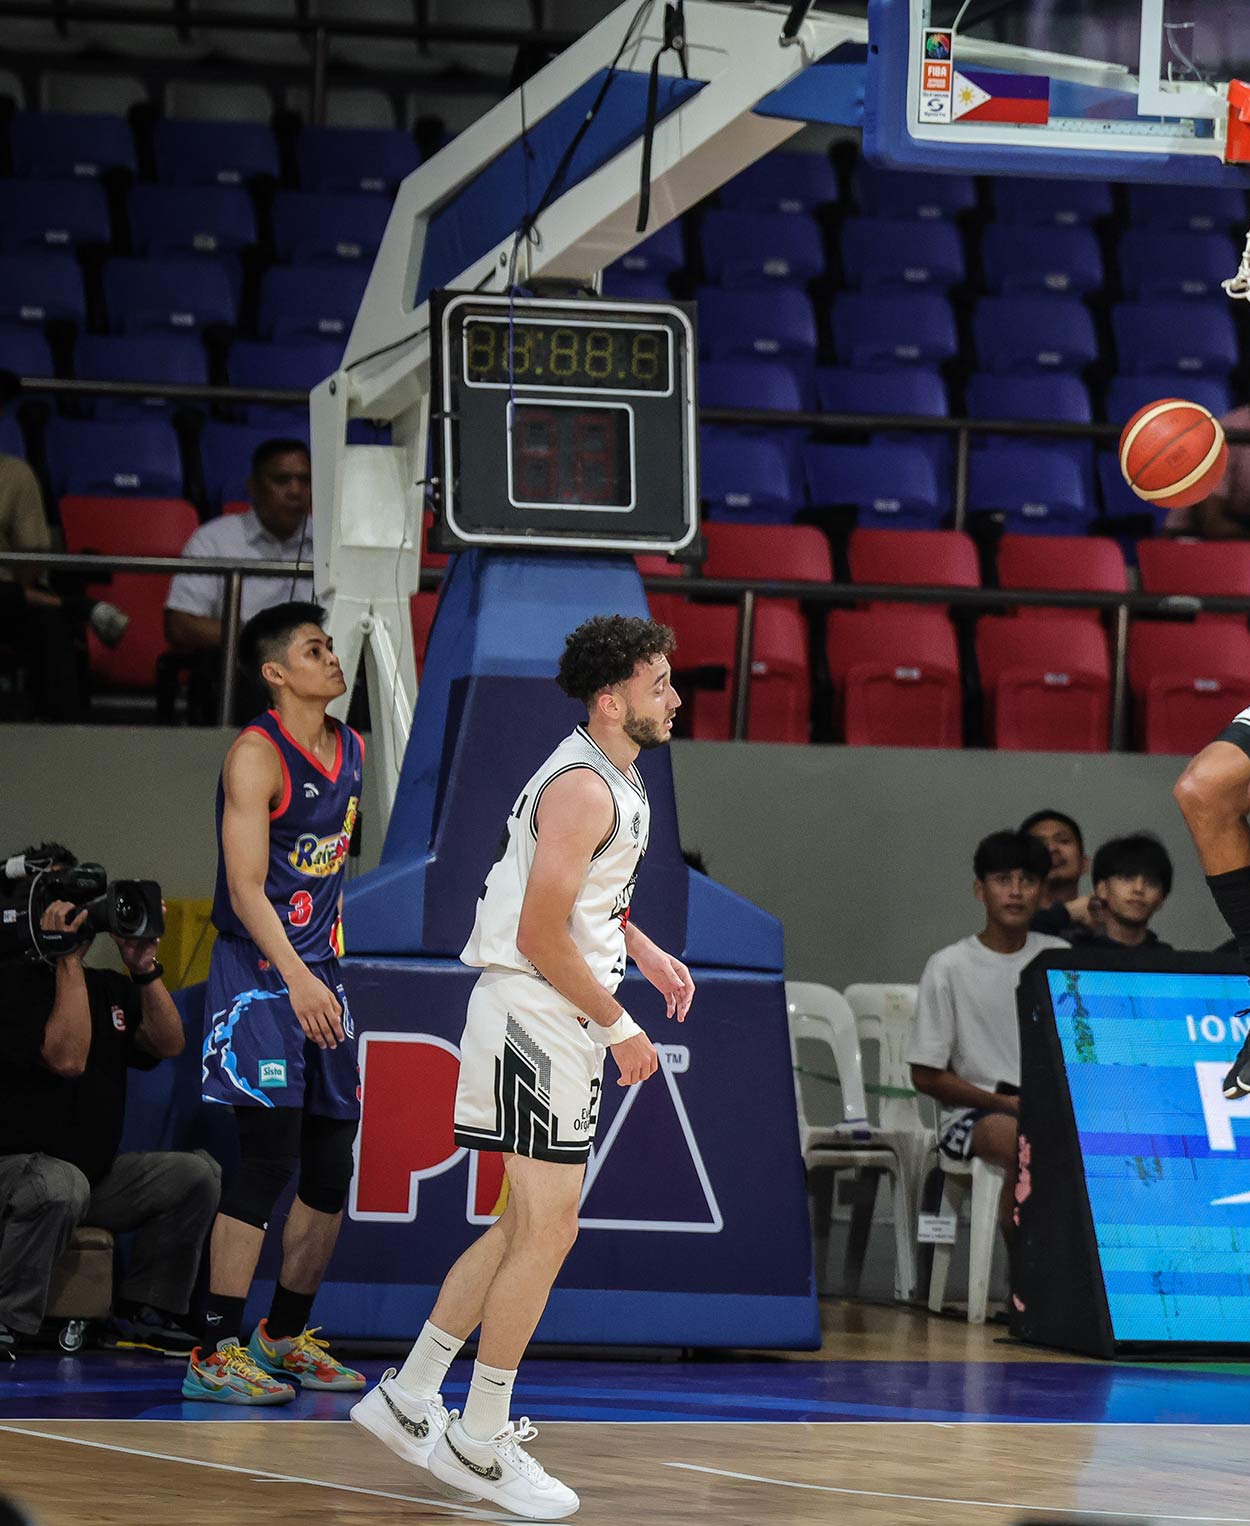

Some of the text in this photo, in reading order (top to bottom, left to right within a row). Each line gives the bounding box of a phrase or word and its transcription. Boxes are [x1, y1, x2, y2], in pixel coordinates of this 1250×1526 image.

[288, 890, 312, 927] 3
[665, 1053, 682, 1064] TM
[263, 1066, 282, 1077] Sista
[348, 1031, 724, 1232] PA
